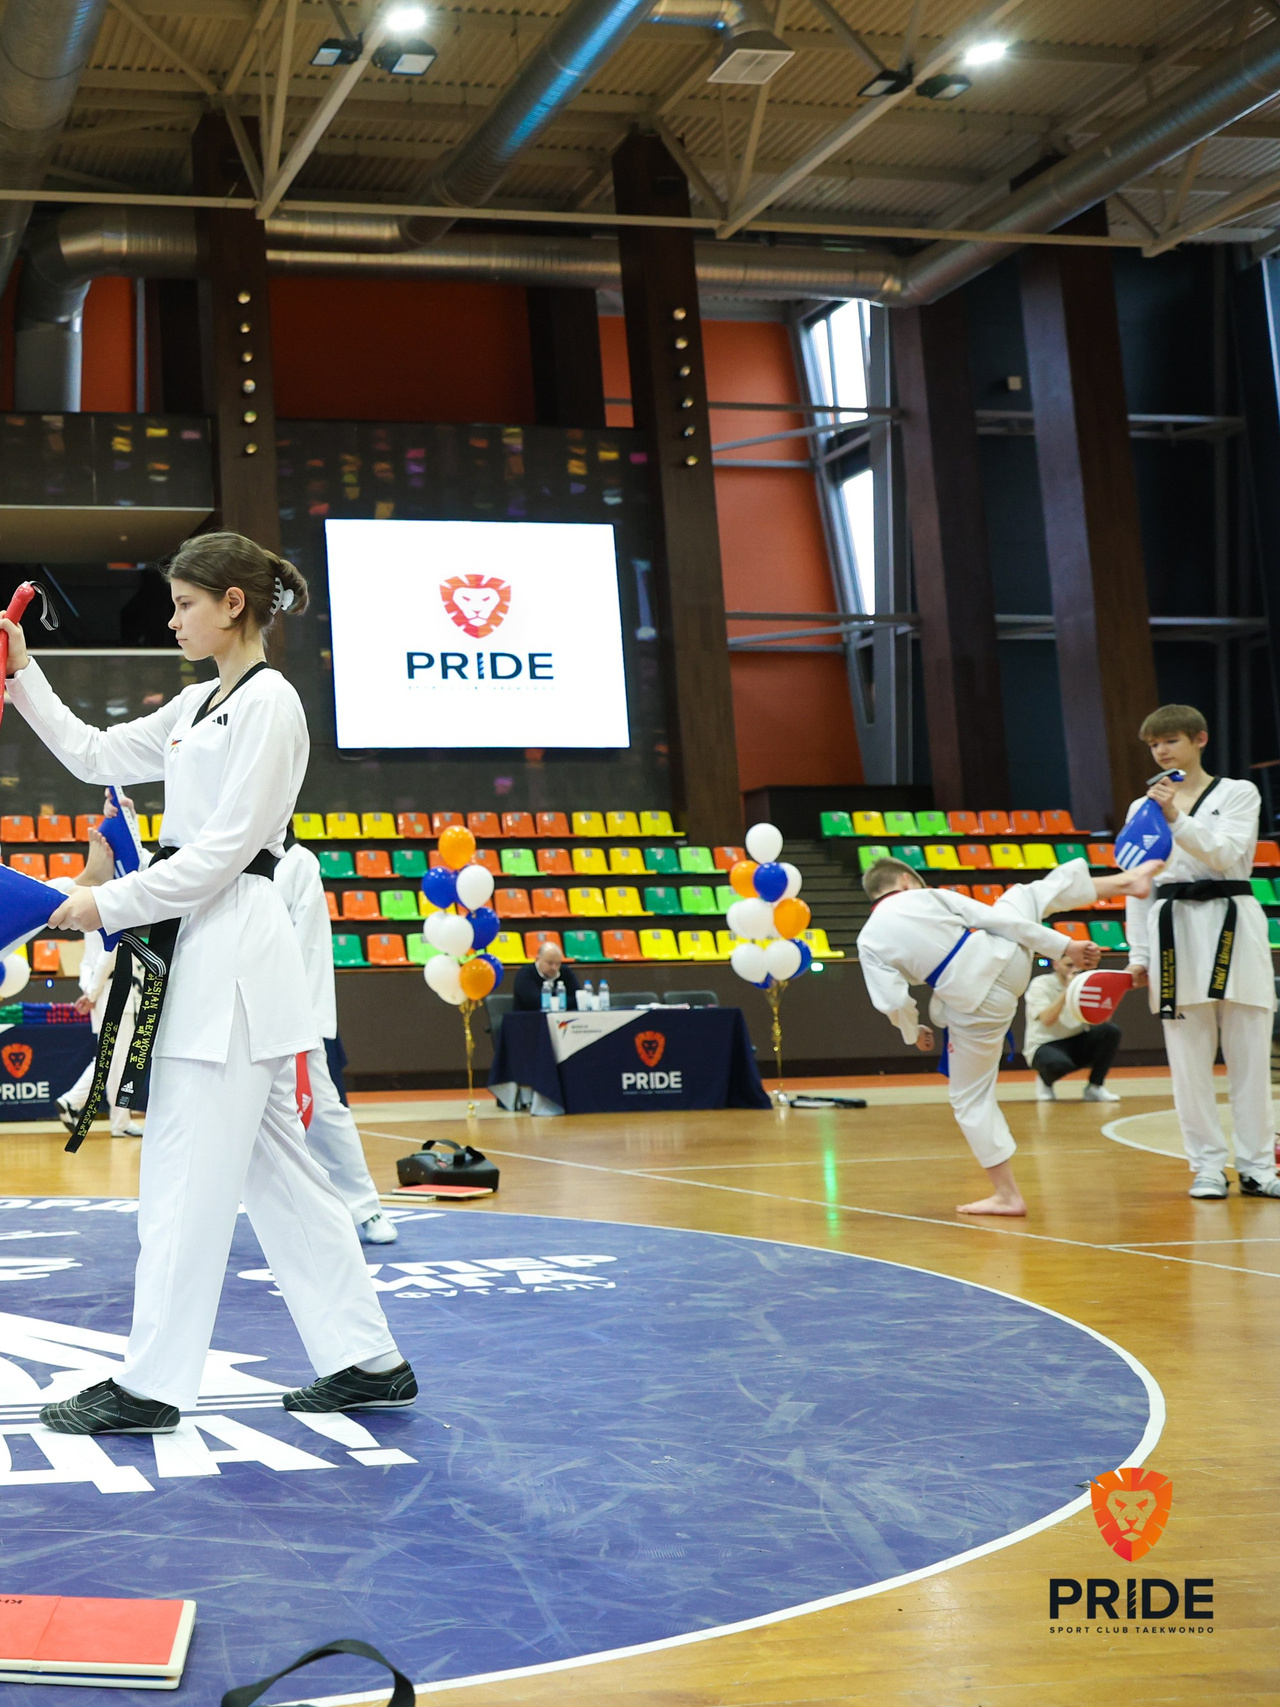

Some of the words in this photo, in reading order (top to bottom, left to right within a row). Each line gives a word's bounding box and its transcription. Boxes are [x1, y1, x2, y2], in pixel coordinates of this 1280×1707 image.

[406, 651, 554, 680] PRIDE
[150, 975, 163, 1009] USSIAN
[136, 1013, 157, 1070] TAEKWONDO
[622, 1071, 682, 1090] PRIDE
[393, 1281, 617, 1300] ФУТЗАЛУ
